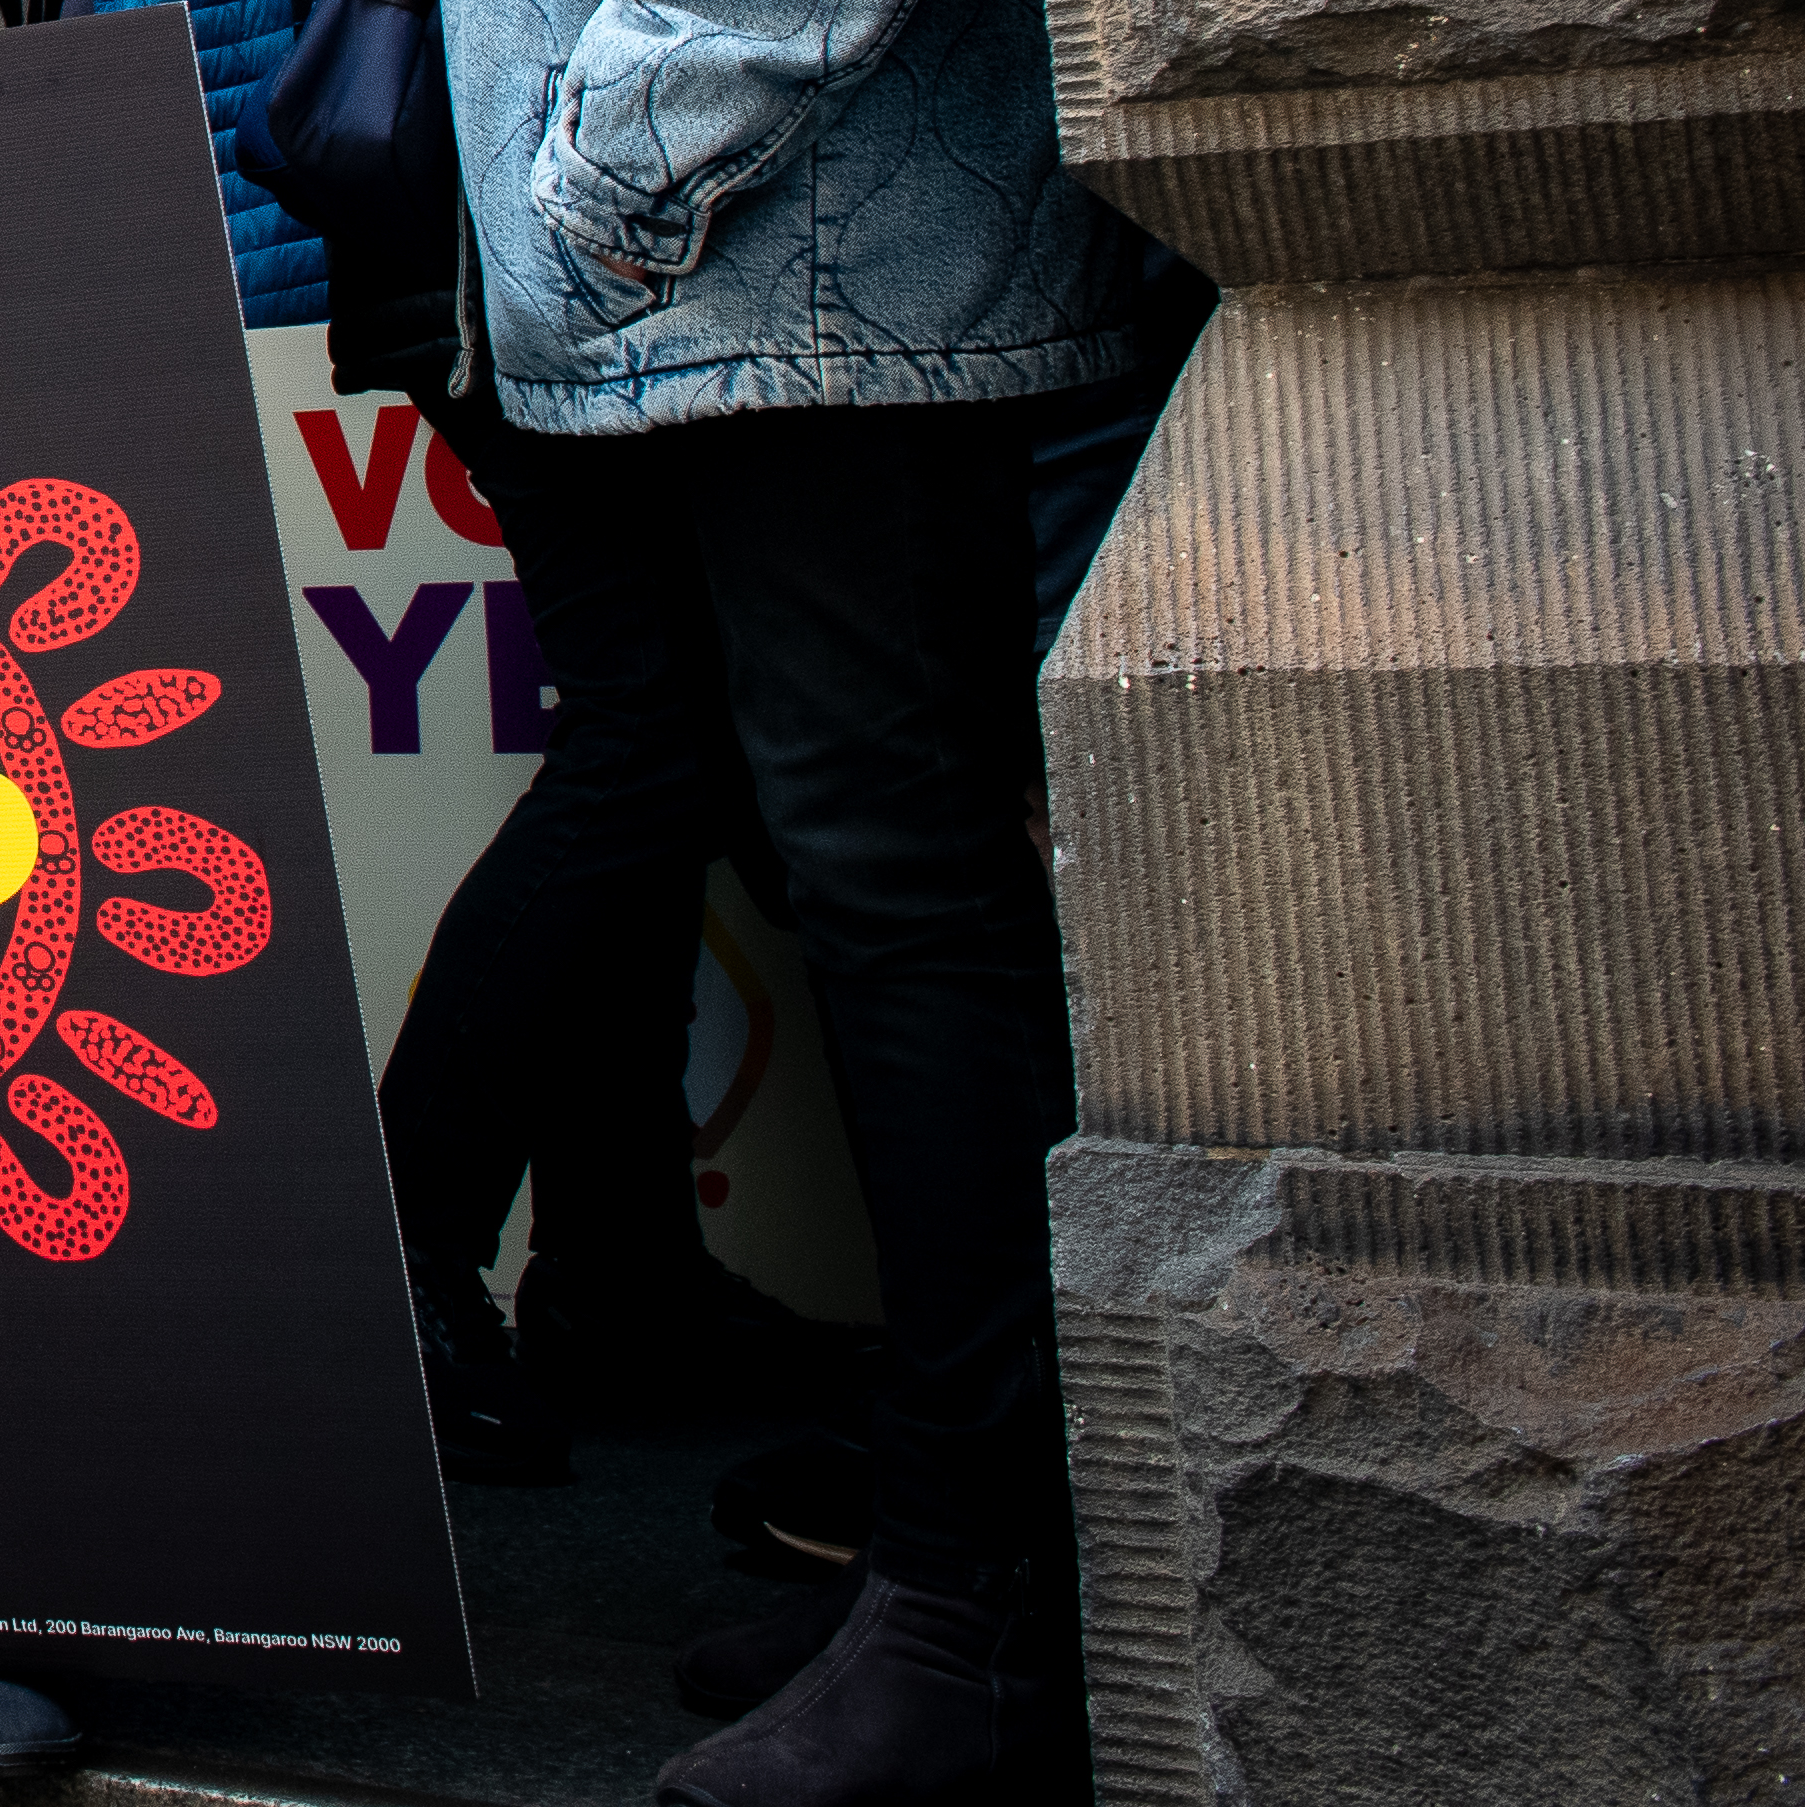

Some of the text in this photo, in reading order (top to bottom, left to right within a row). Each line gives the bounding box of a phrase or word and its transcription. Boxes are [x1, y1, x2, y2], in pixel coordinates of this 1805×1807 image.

[12, 1617, 43, 1636] Ltd,
[45, 1619, 78, 1635] 200
[81, 1621, 173, 1642] Barangaroo
[176, 1626, 210, 1645] Ave,
[213, 1627, 308, 1648] Barangaroo
[311, 1632, 352, 1651] NSW
[356, 1635, 402, 1653] 2000
